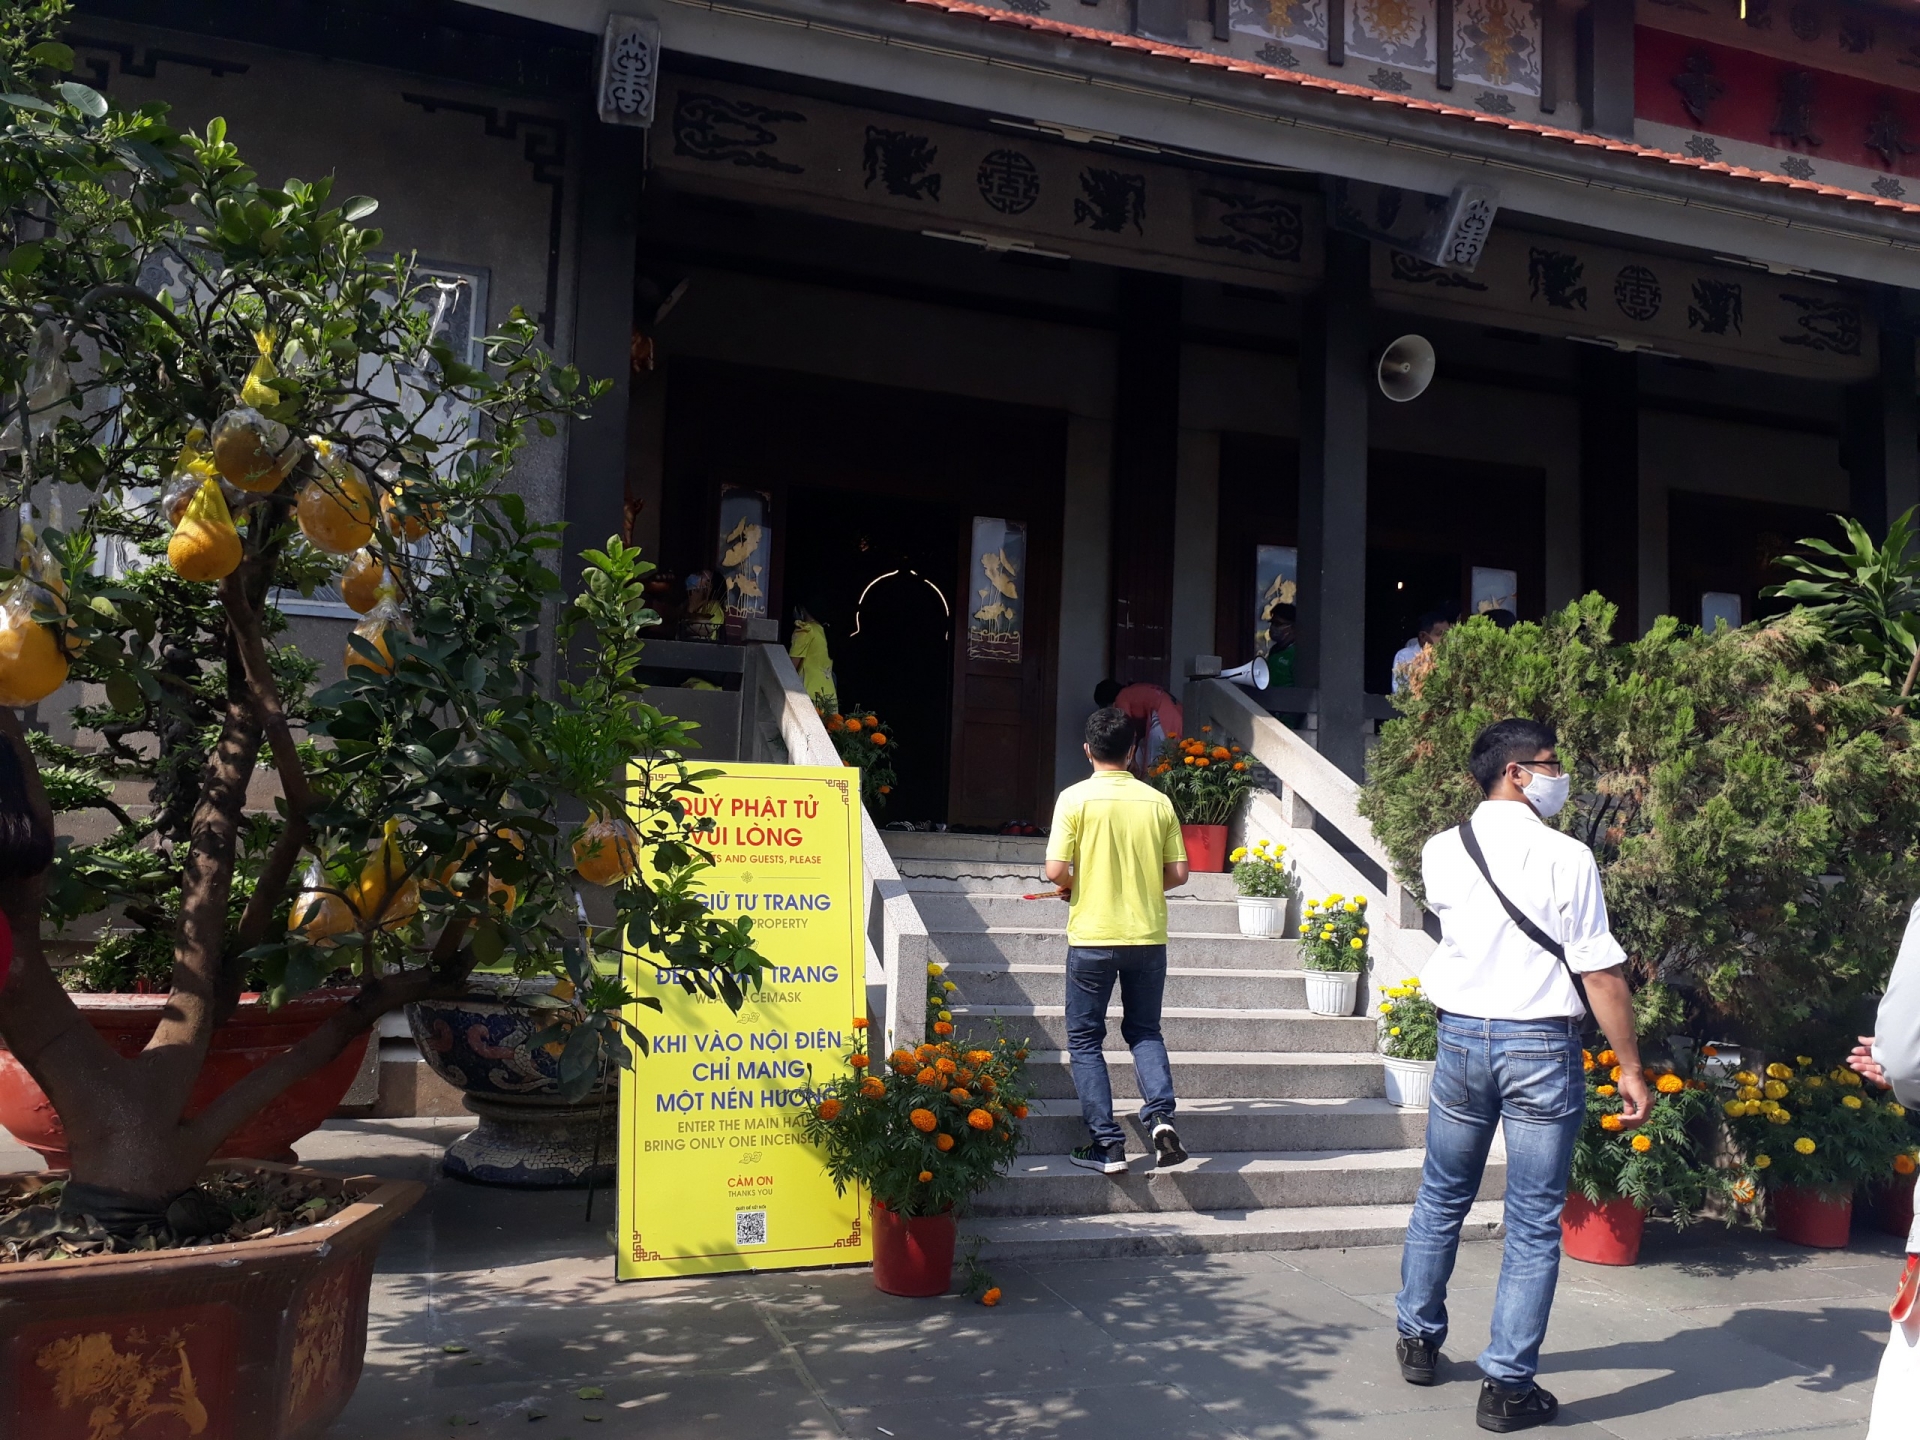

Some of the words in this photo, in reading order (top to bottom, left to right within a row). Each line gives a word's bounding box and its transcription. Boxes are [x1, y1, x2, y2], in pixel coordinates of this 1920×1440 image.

[675, 793, 724, 817] QUÝ
[731, 796, 788, 822] PHẬT
[793, 794, 820, 819] TỬ
[691, 827, 727, 845] VUI
[736, 822, 803, 847] LÒNG
[724, 855, 746, 863] AND
[749, 854, 787, 865] GUESTS,
[789, 856, 822, 865] PLEASE
[735, 894, 758, 911] TƯ
[763, 894, 831, 911] TRANG
[752, 918, 809, 929] PROPERTY
[772, 966, 839, 984] TRANG
[742, 992, 802, 1004] ACEMASK
[653, 1035, 687, 1053] KHI
[694, 1030, 743, 1052] VÀO
[750, 1029, 788, 1053] NỘI
[795, 1028, 841, 1052] ĐIỆN
[692, 1056, 730, 1081] CHỈ
[737, 1060, 805, 1080] MANG
[656, 1089, 704, 1115] MỘT
[711, 1087, 753, 1110] NÉN
[678, 1120, 715, 1133] ENTER
[719, 1118, 740, 1131] THE
[744, 1117, 779, 1130] MAIN
[644, 1139, 686, 1152] BRING
[689, 1136, 725, 1150] ONLY
[728, 1135, 757, 1148] ONE
[727, 1174, 754, 1188] CẢM
[756, 1175, 773, 1187] ƠN
[728, 1190, 756, 1198] THANKS
[758, 1188, 773, 1197] YOU
